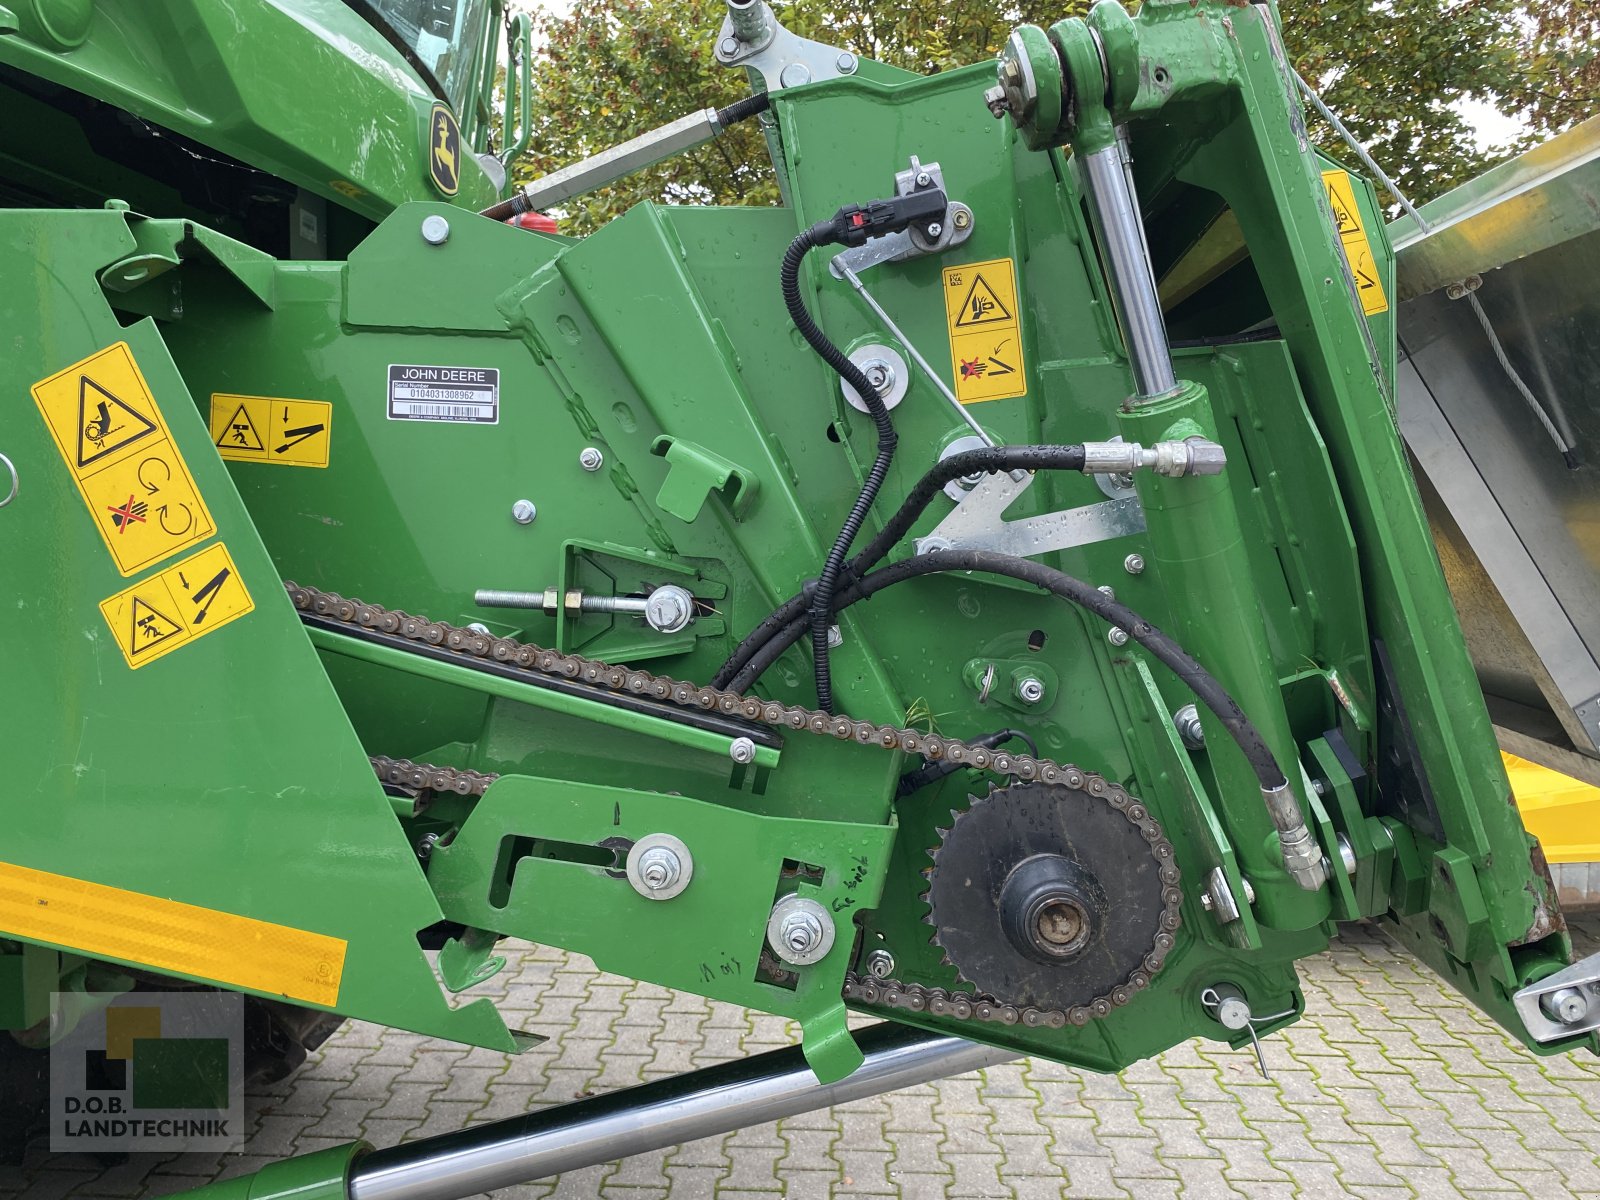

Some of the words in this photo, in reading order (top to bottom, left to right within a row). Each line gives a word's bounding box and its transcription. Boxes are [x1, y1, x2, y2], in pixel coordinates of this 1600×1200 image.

[402, 368, 437, 380] JOHN
[441, 370, 485, 382] DEERE
[410, 389, 474, 400] 0104031308962
